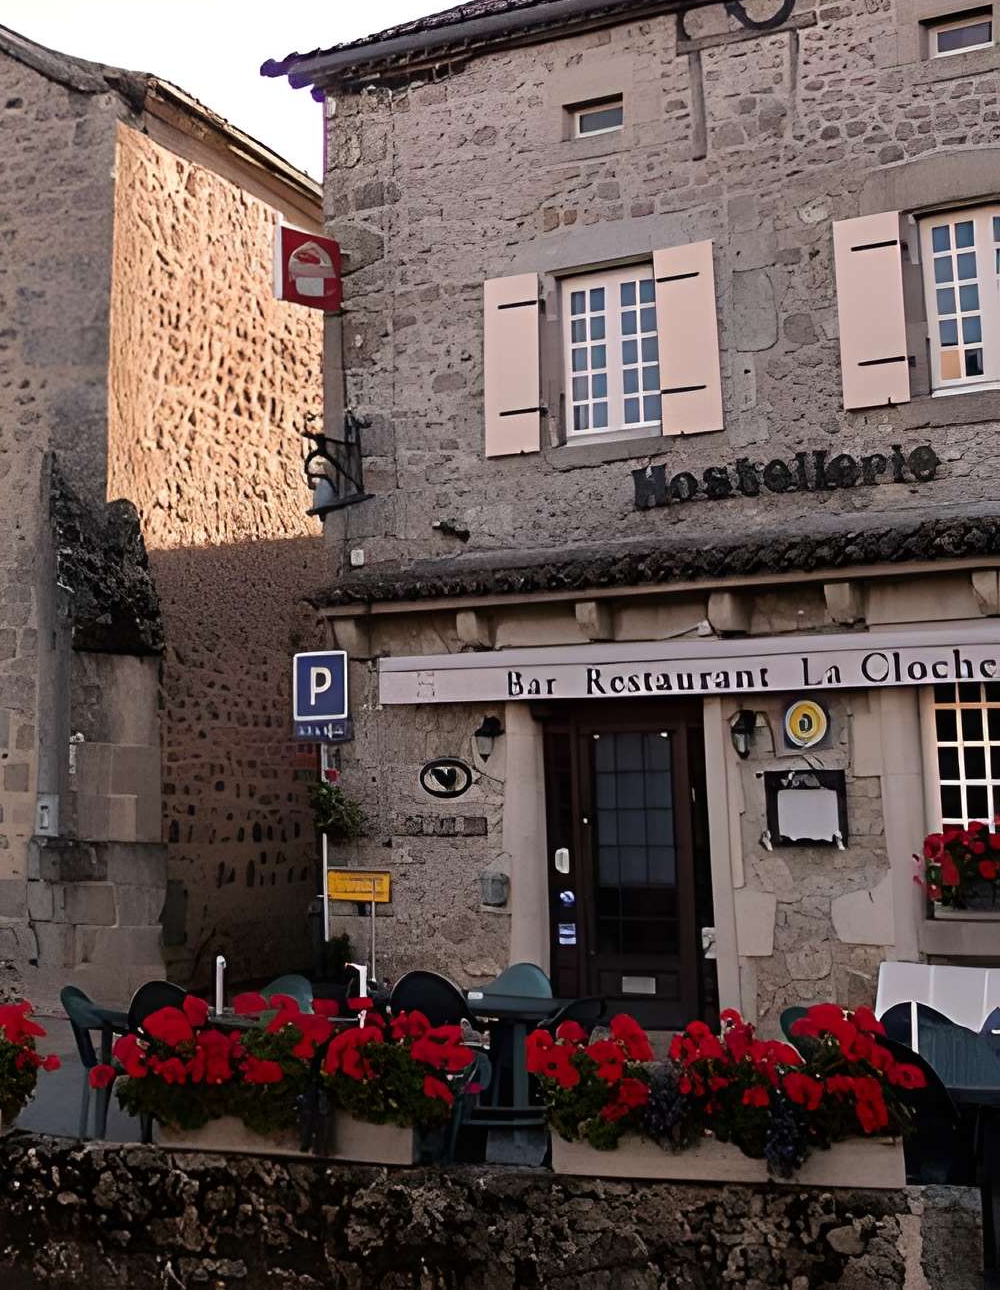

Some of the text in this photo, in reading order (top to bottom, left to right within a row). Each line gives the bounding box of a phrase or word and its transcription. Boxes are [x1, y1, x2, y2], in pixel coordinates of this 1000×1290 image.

[631, 445, 942, 510] Hostellerie
[310, 666, 332, 706] P
[507, 670, 557, 696] Bar
[586, 667, 769, 695] Restaurant
[801, 657, 842, 686] La
